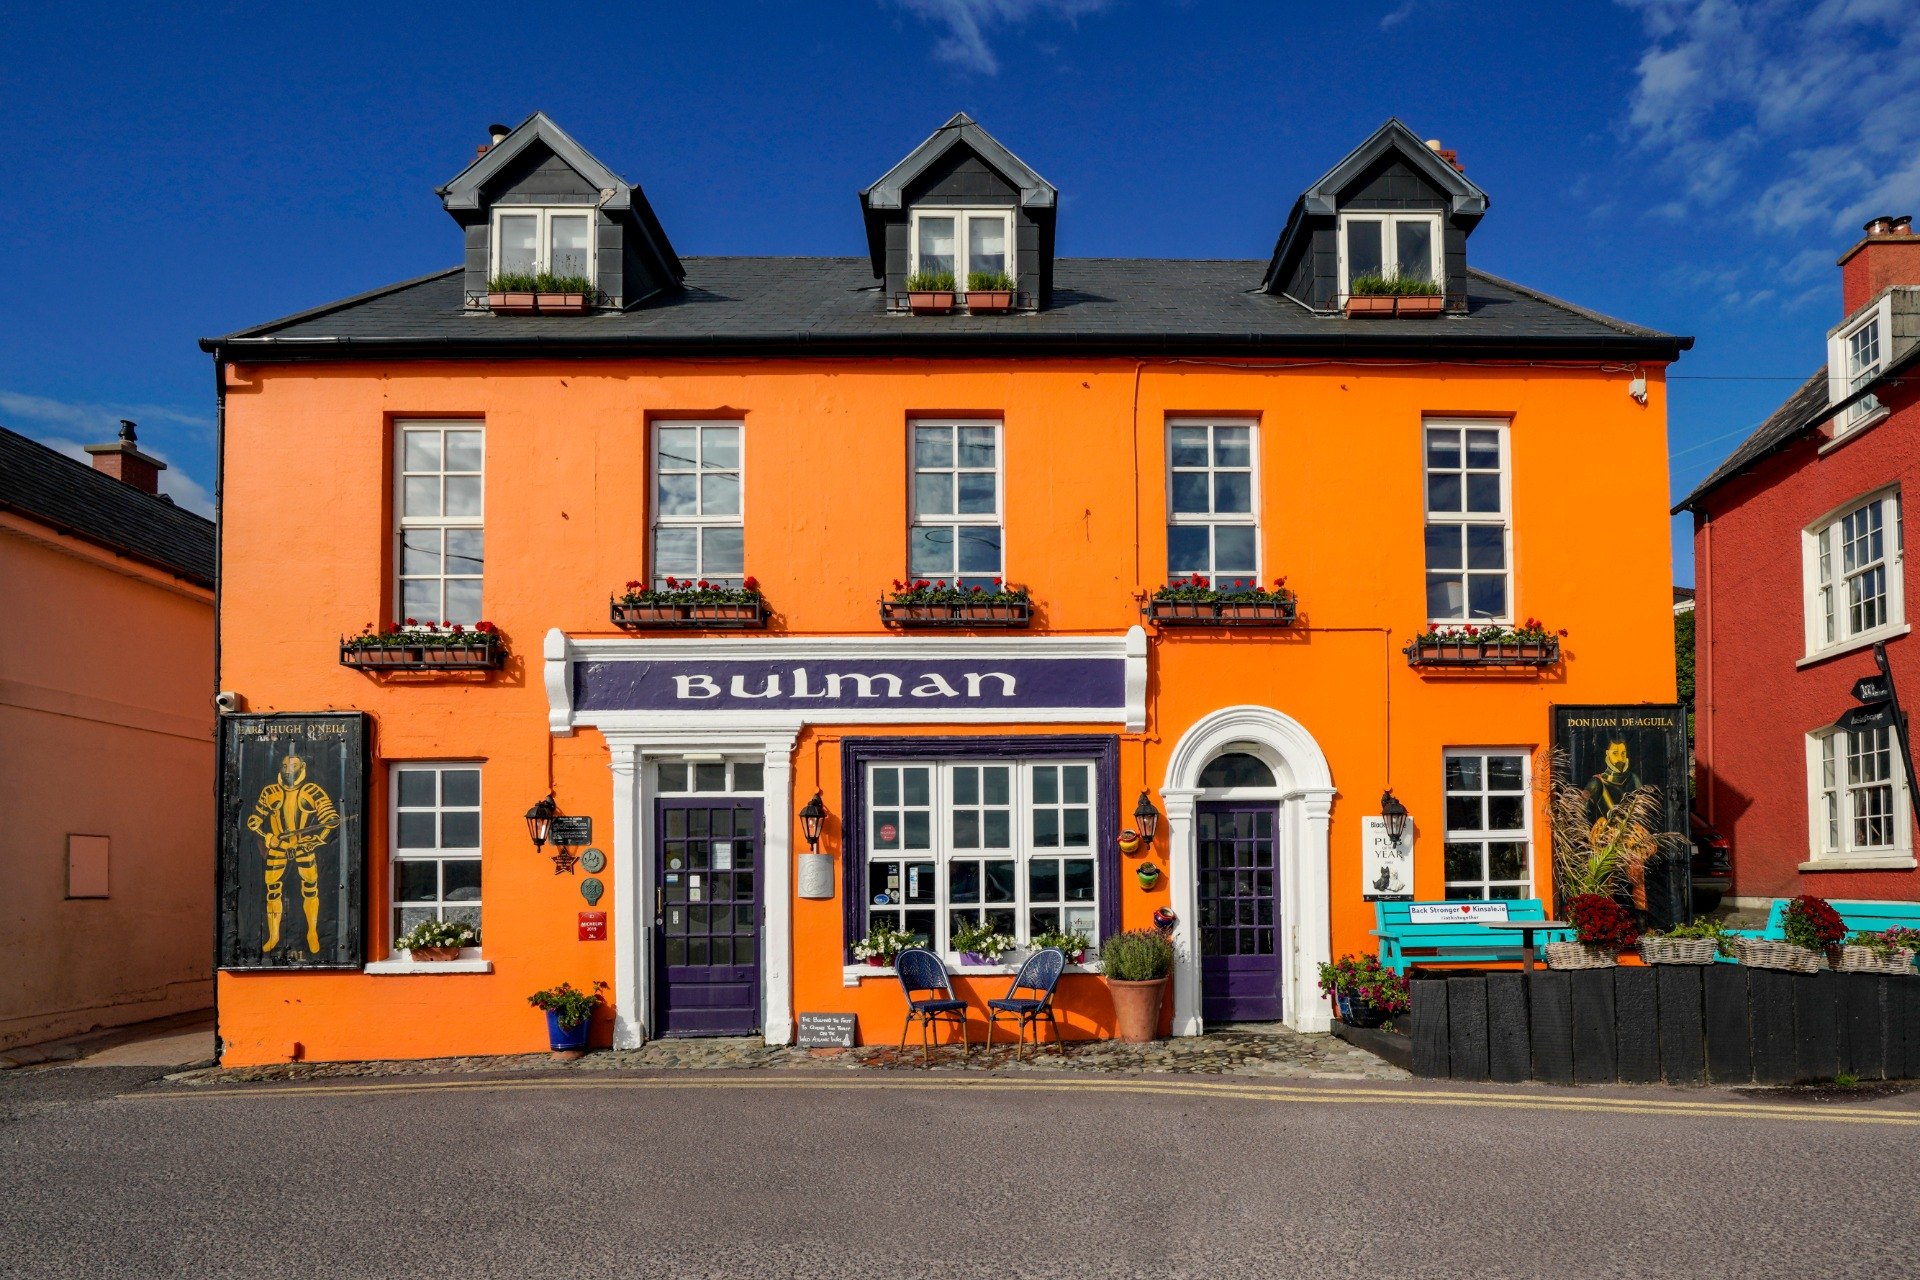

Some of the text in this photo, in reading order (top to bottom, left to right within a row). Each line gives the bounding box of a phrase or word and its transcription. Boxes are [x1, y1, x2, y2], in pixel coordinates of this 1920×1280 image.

[1568, 718, 1590, 727] DON
[1591, 718, 1617, 727] JUAN
[1636, 717, 1674, 727] AGUILA
[270, 724, 302, 734] HUGH
[307, 724, 348, 734] O'NEILL
[1374, 850, 1403, 859] YEAR
[1429, 906, 1460, 915] Stronger
